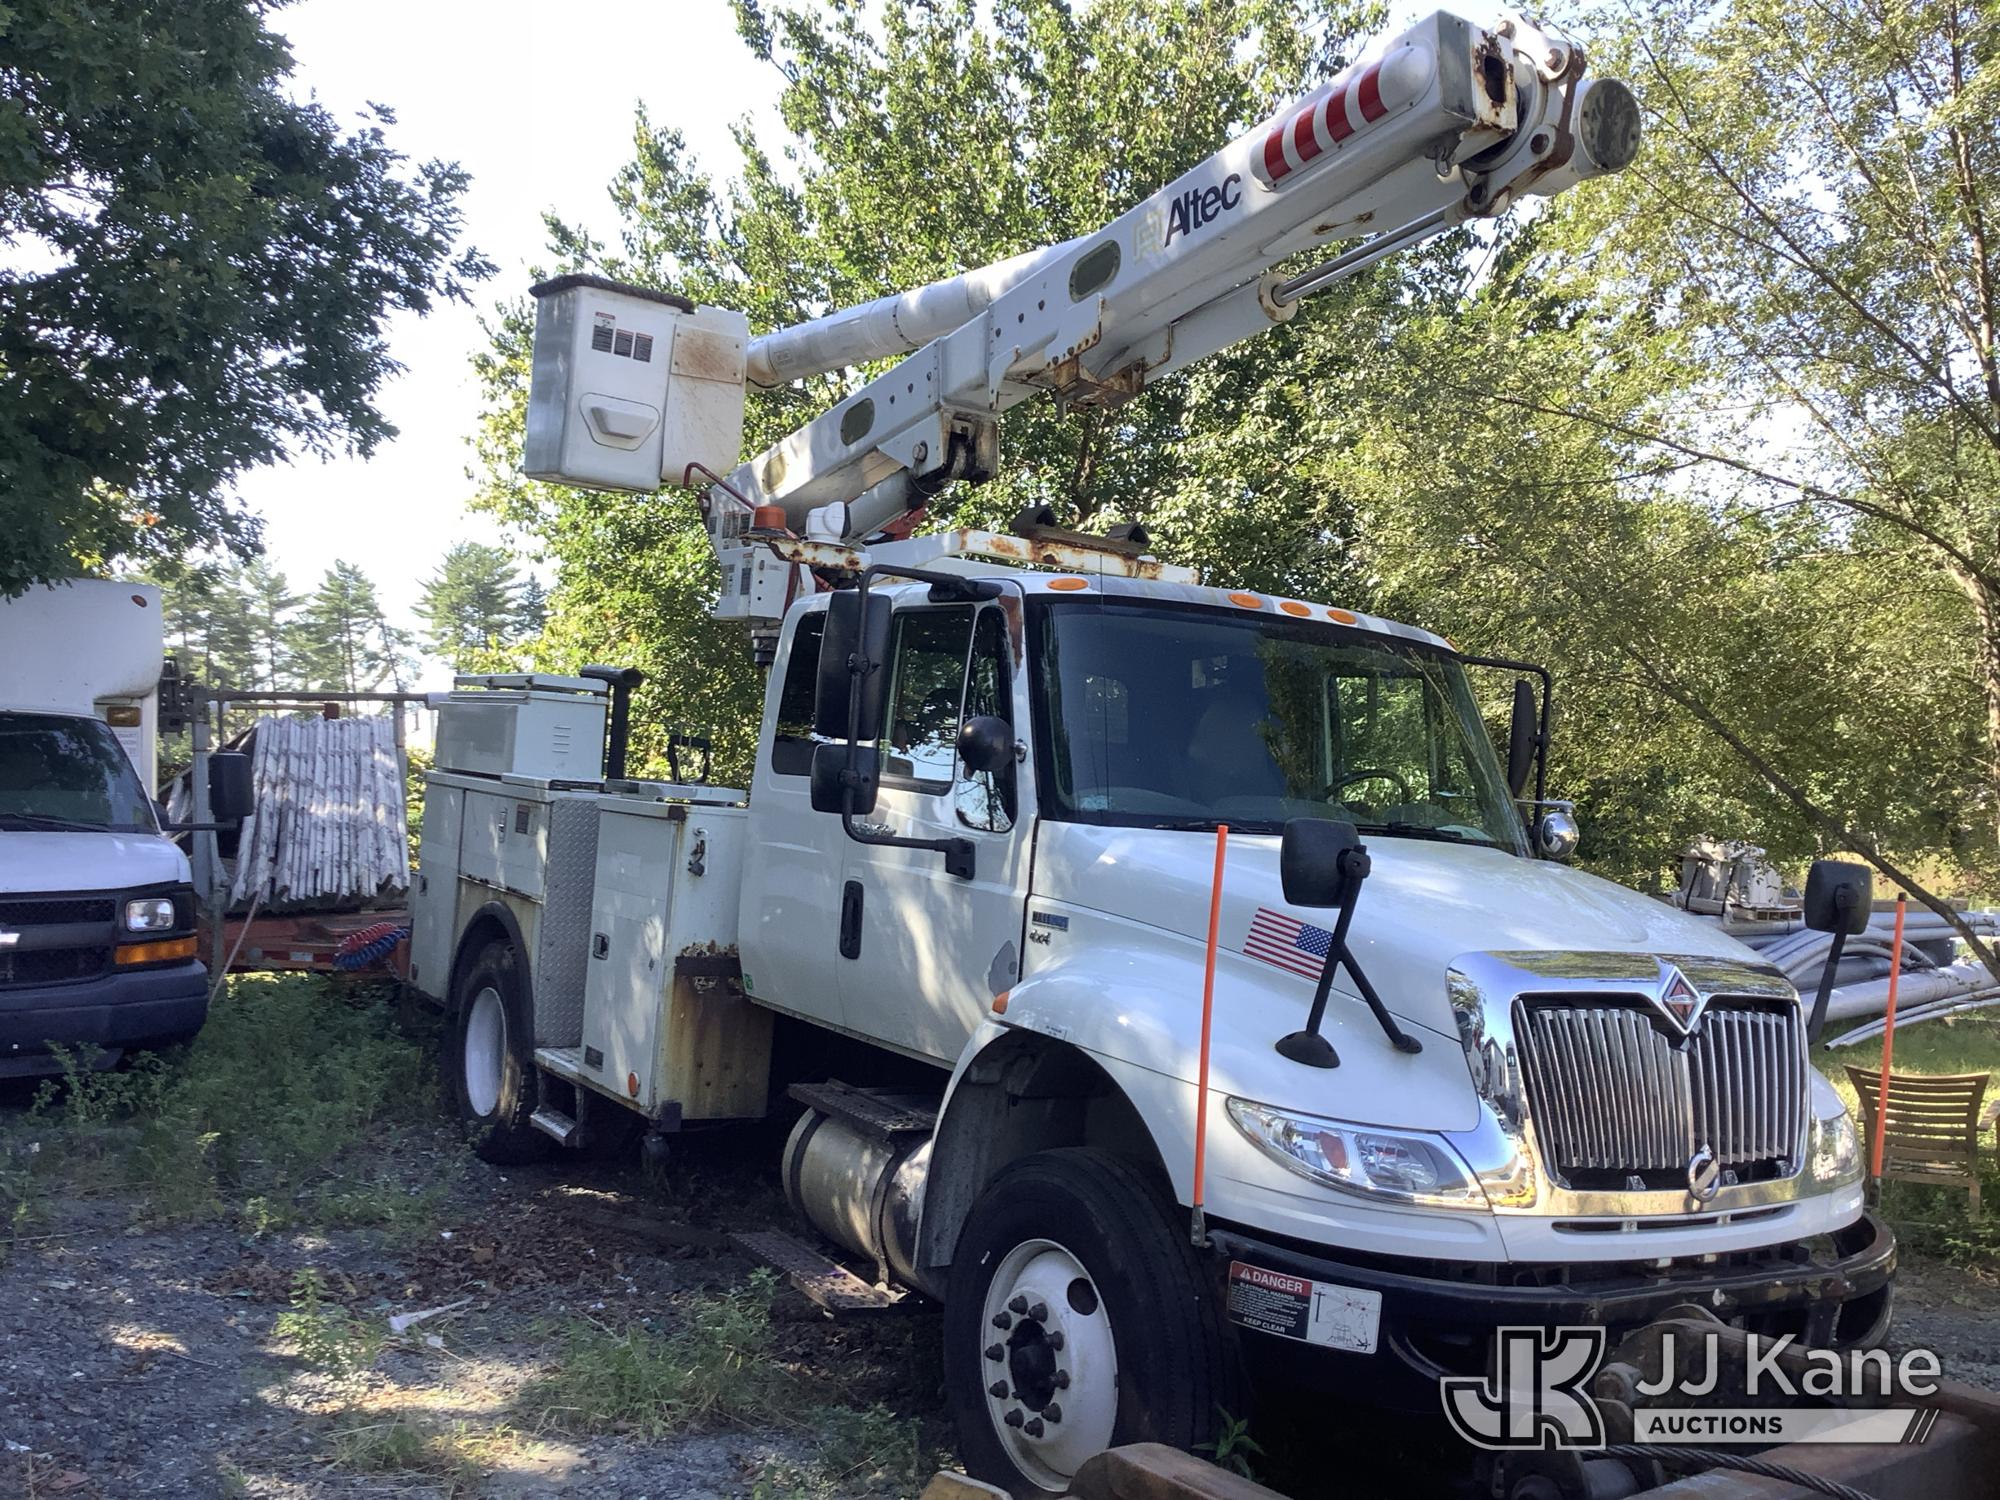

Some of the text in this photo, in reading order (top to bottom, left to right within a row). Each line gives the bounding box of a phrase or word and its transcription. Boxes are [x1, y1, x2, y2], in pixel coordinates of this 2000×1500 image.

[1164, 173, 1241, 248] Altec
[1252, 1271, 1303, 1293] DANGER
[1243, 1316, 1286, 1333] KEEP CLEAR
